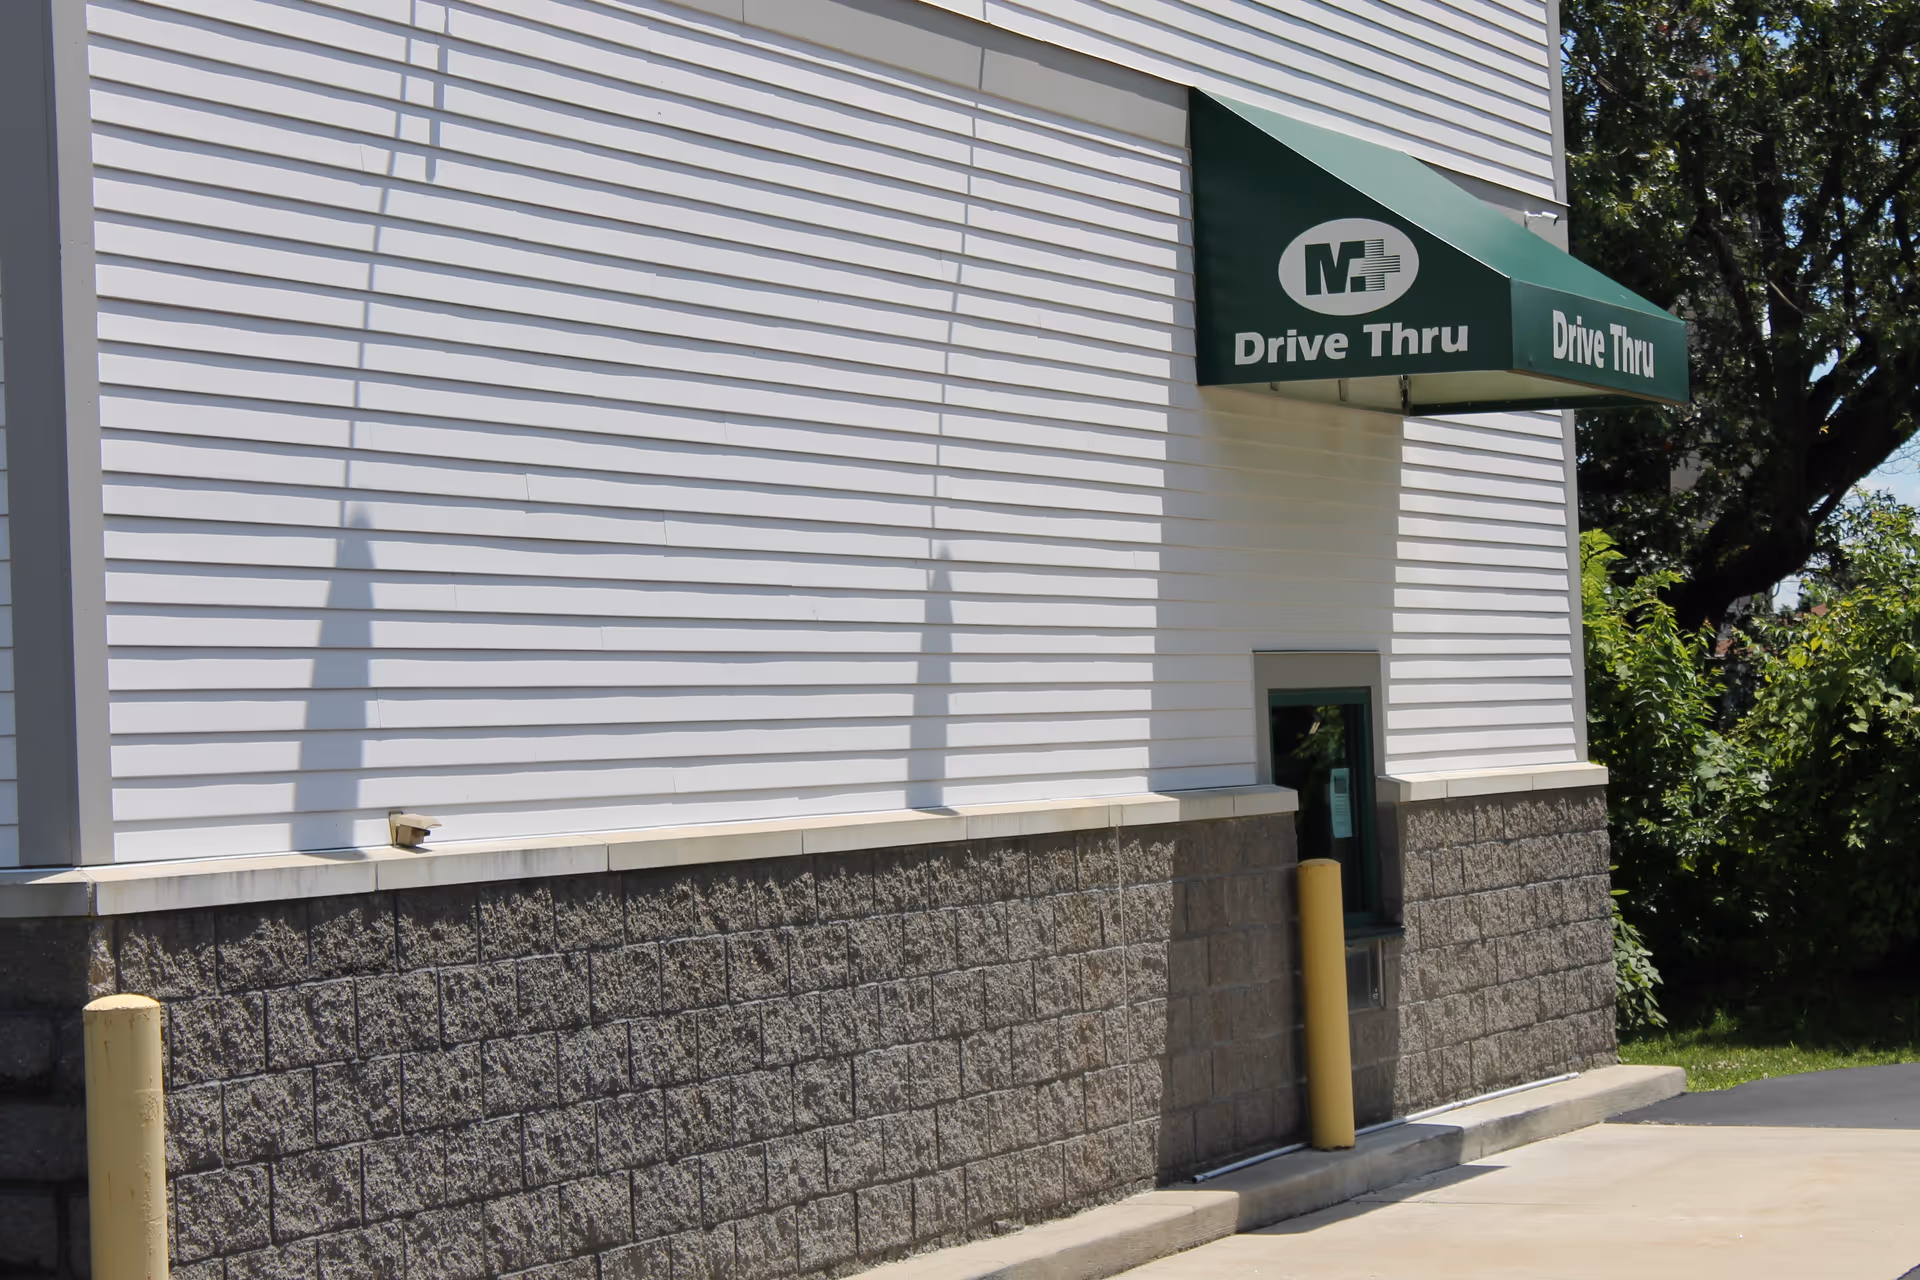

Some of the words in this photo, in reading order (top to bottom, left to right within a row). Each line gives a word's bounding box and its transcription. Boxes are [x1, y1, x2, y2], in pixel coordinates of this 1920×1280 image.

[1234, 329, 1349, 365] Drive
[1363, 322, 1469, 357] Thru
[1552, 309, 1605, 369] Drive
[1609, 322, 1656, 378] Thru
